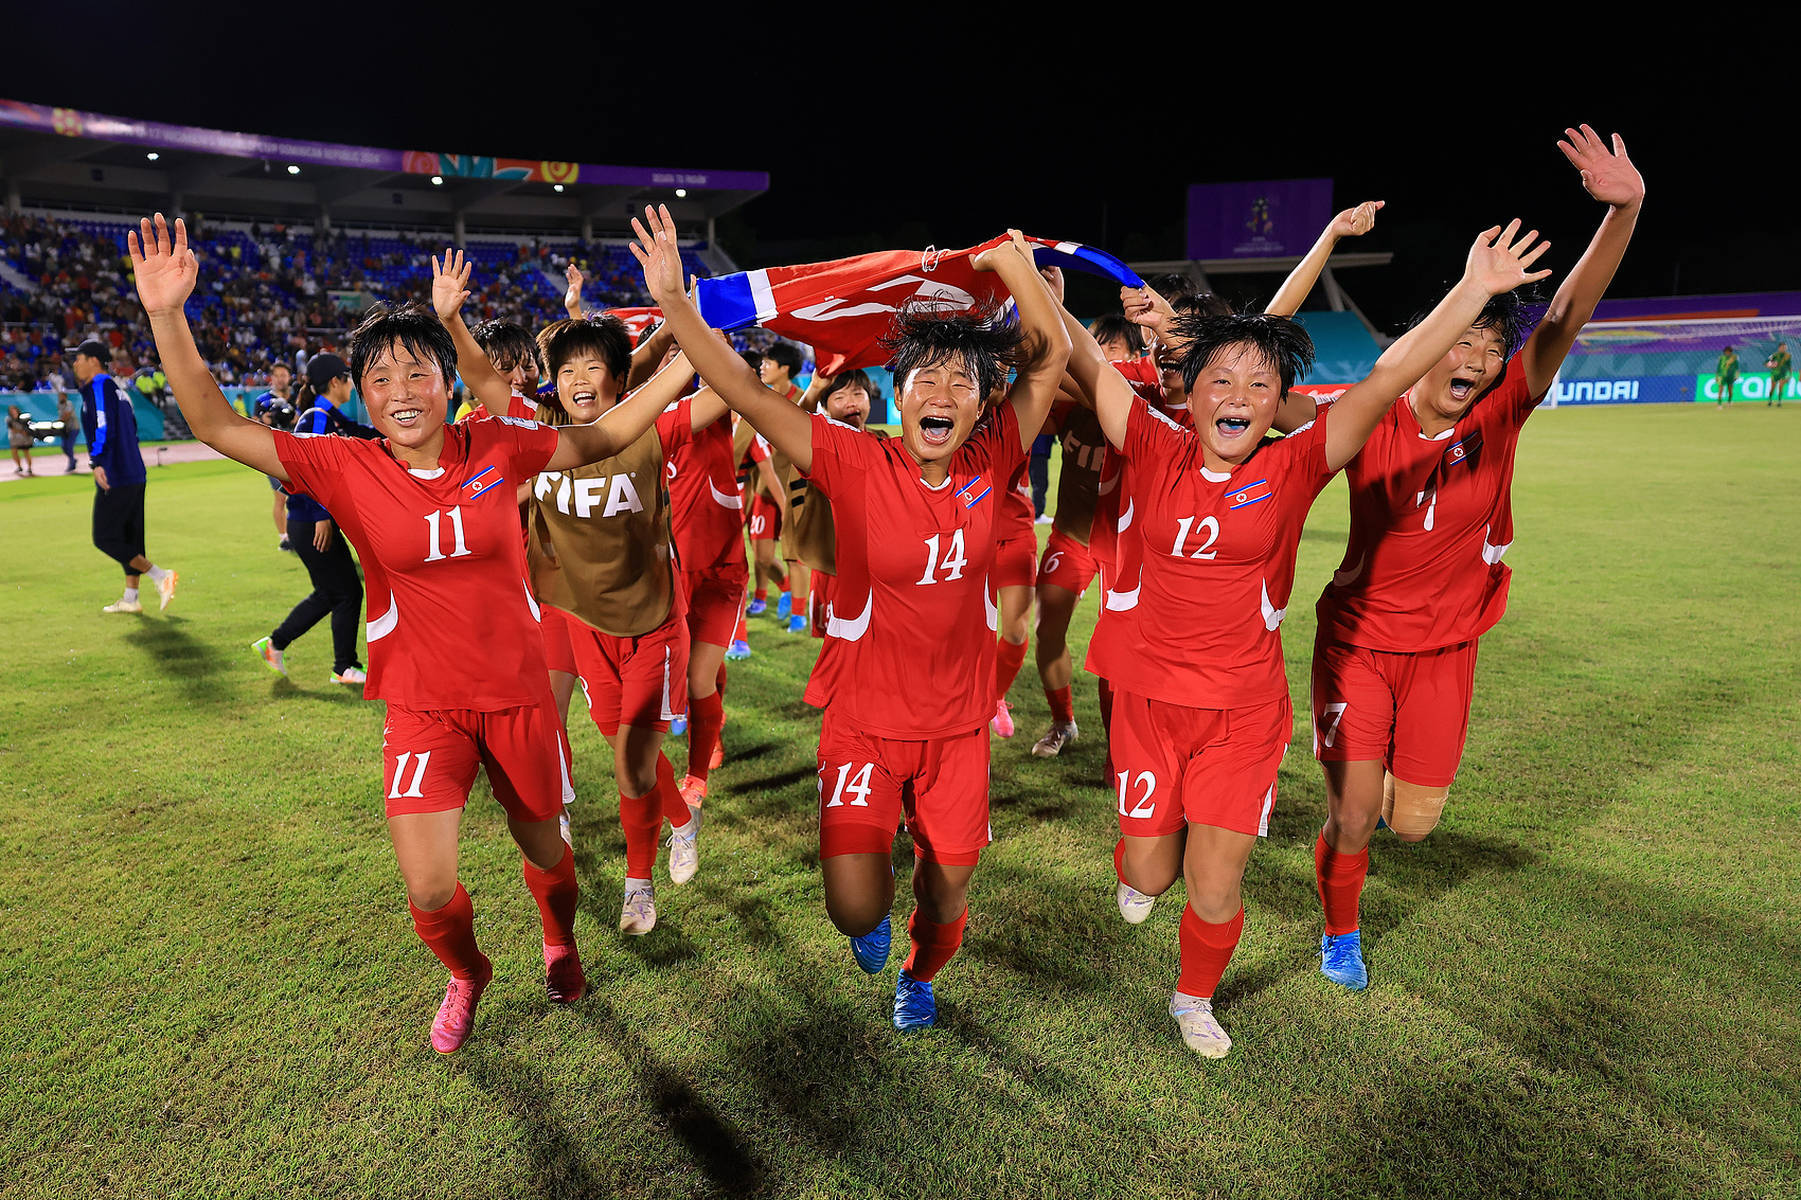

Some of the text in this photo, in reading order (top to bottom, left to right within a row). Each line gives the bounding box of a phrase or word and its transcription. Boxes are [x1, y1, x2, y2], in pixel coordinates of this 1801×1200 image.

[1417, 484, 1437, 531] 7
[424, 504, 472, 562] 11
[915, 528, 968, 585] 14
[1170, 515, 1220, 560] 12
[1043, 551, 1065, 574] 6
[1323, 702, 1348, 748] 7
[387, 750, 431, 799] 11
[826, 761, 875, 808] 14
[1116, 768, 1157, 819] 12
